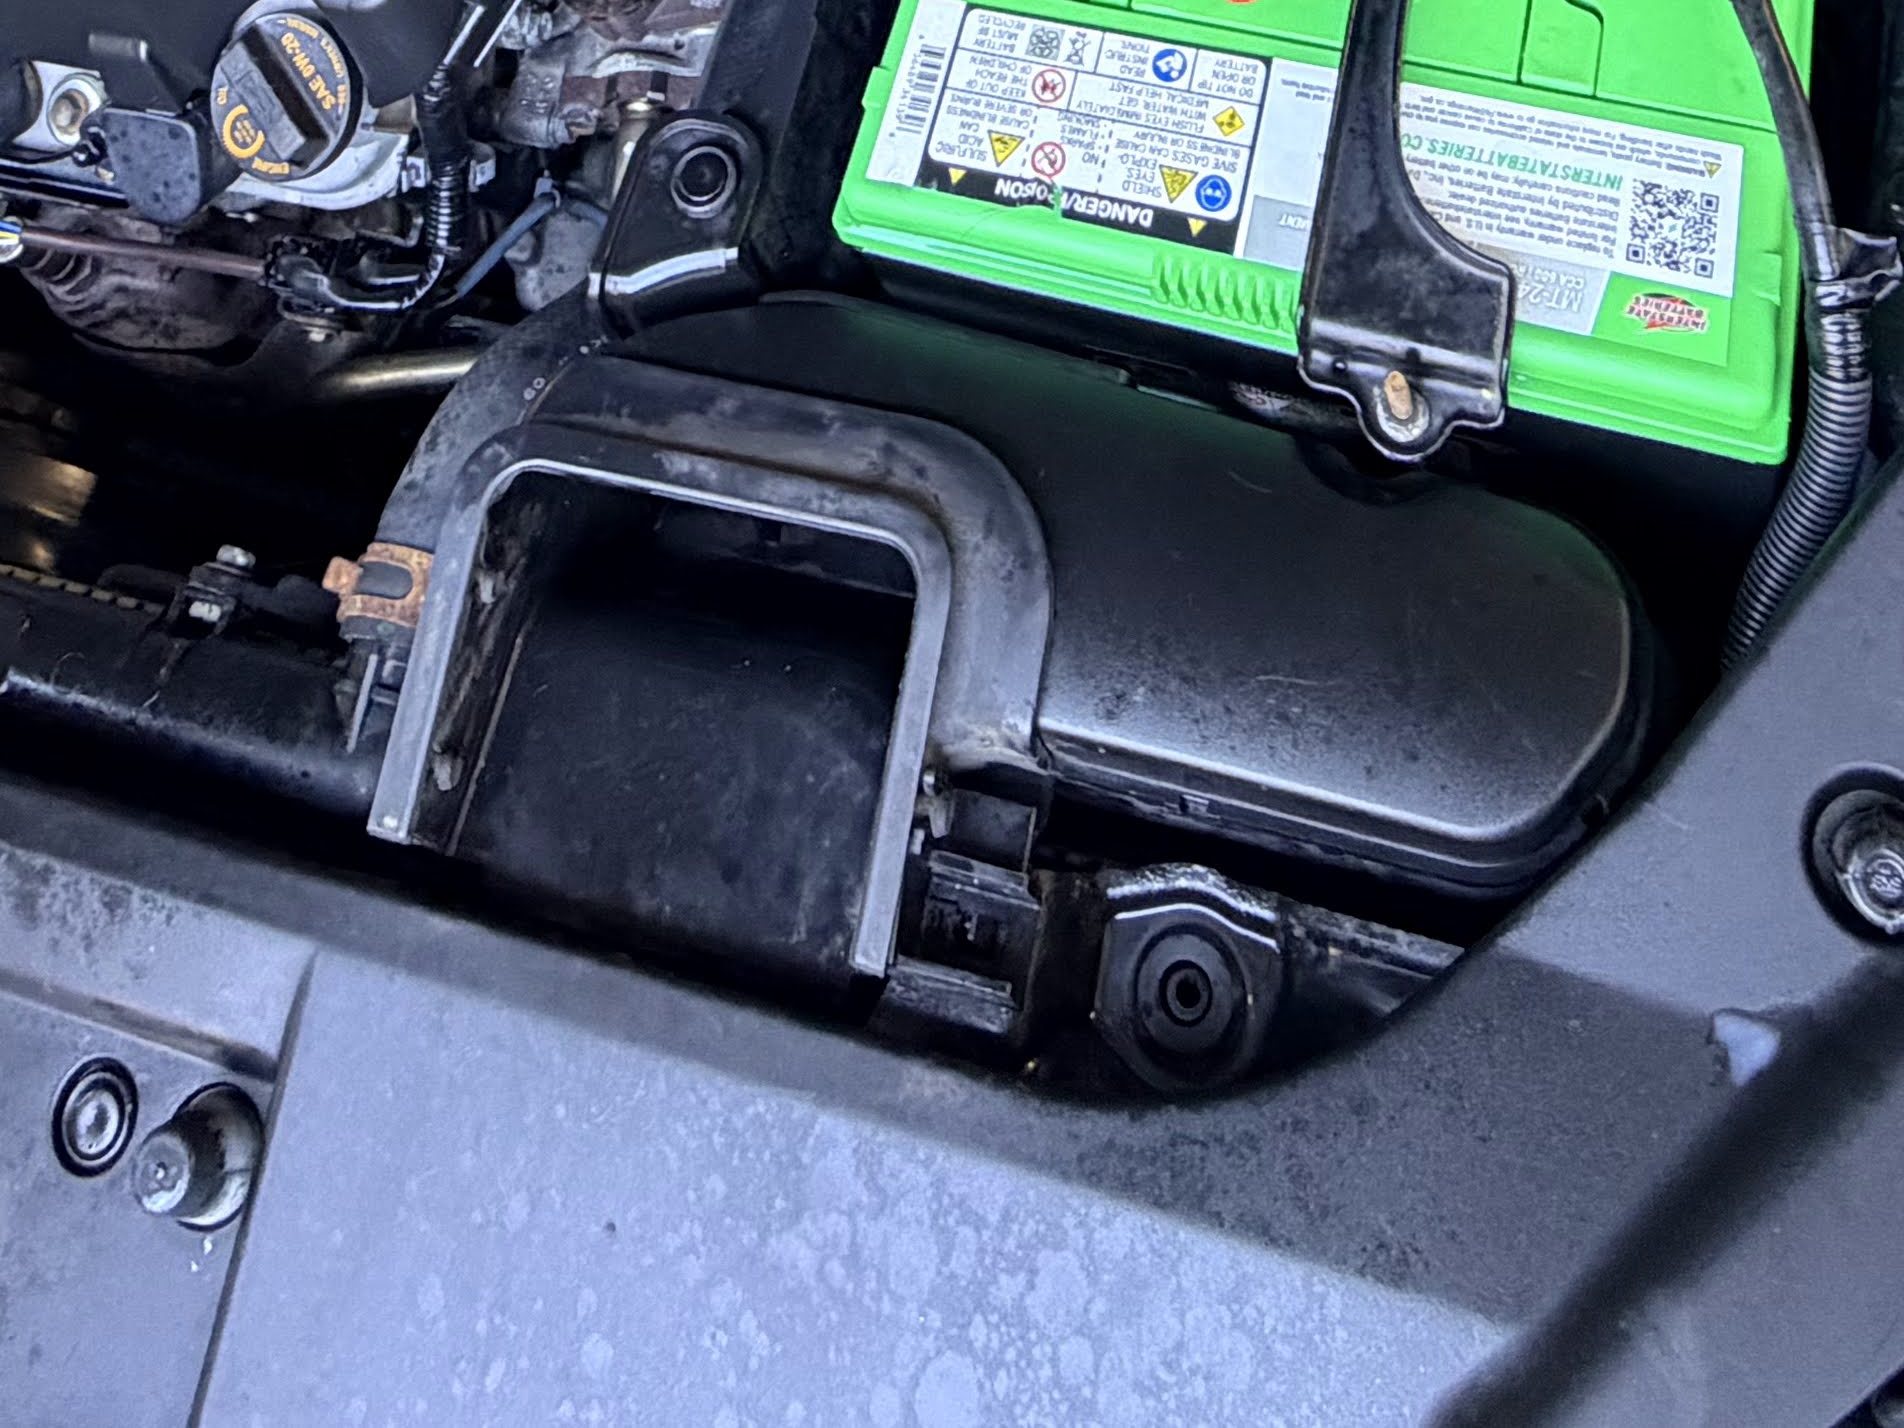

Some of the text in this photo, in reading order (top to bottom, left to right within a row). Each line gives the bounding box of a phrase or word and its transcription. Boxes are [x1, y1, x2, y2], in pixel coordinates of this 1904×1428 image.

[977, 12, 1026, 31] RECYCLED
[992, 28, 1018, 41] MUST
[974, 36, 1015, 53] BATTERY
[281, 32, 337, 110] SAE 0W-20
[969, 53, 1031, 74] OF CHILDREN
[1119, 64, 1145, 78] READ
[1214, 56, 1258, 74] BATTERY
[974, 67, 1028, 86] THE REACH
[1211, 68, 1256, 86] OR OPEN
[965, 78, 1026, 98] KEEP OUT OF
[1108, 80, 1209, 109] MEDICAL HELP FAST
[1196, 78, 1253, 98] DO NOT TIP
[949, 92, 1033, 117] OR SEVERE BURNS
[1117, 95, 1139, 108] GET
[946, 103, 1030, 130] CAUSE BLINDNESS
[1076, 98, 1204, 133] FLUSH EYES IMMEDIATELY
[1180, 107, 1206, 121] WITH
[958, 119, 979, 132] CAN
[1060, 123, 1099, 140] FLAMES
[957, 132, 983, 147] ACID
[1059, 134, 1095, 150] SPARKS
[1170, 136, 1184, 147] OR
[1185, 138, 1241, 159] BLINDNESS
[935, 140, 987, 162] SULFURIC
[1081, 150, 1099, 164] NO
[1114, 137, 1237, 173] SIVE GASES CAN CAUSE
[1116, 151, 1157, 170] EXPLO-
[1120, 178, 1163, 198] SHIELD
[1495, 186, 1545, 206] Interstate
[1546, 194, 1560, 209] by
[1596, 193, 1620, 207] Read
[1561, 200, 1619, 221] Distributed
[1572, 216, 1617, 233] Interstate
[1601, 246, 1614, 258] To
[1556, 271, 1585, 288] CCA
[1631, 295, 1705, 318] BATTERIES
[1625, 304, 1706, 330] INTERSTATE
